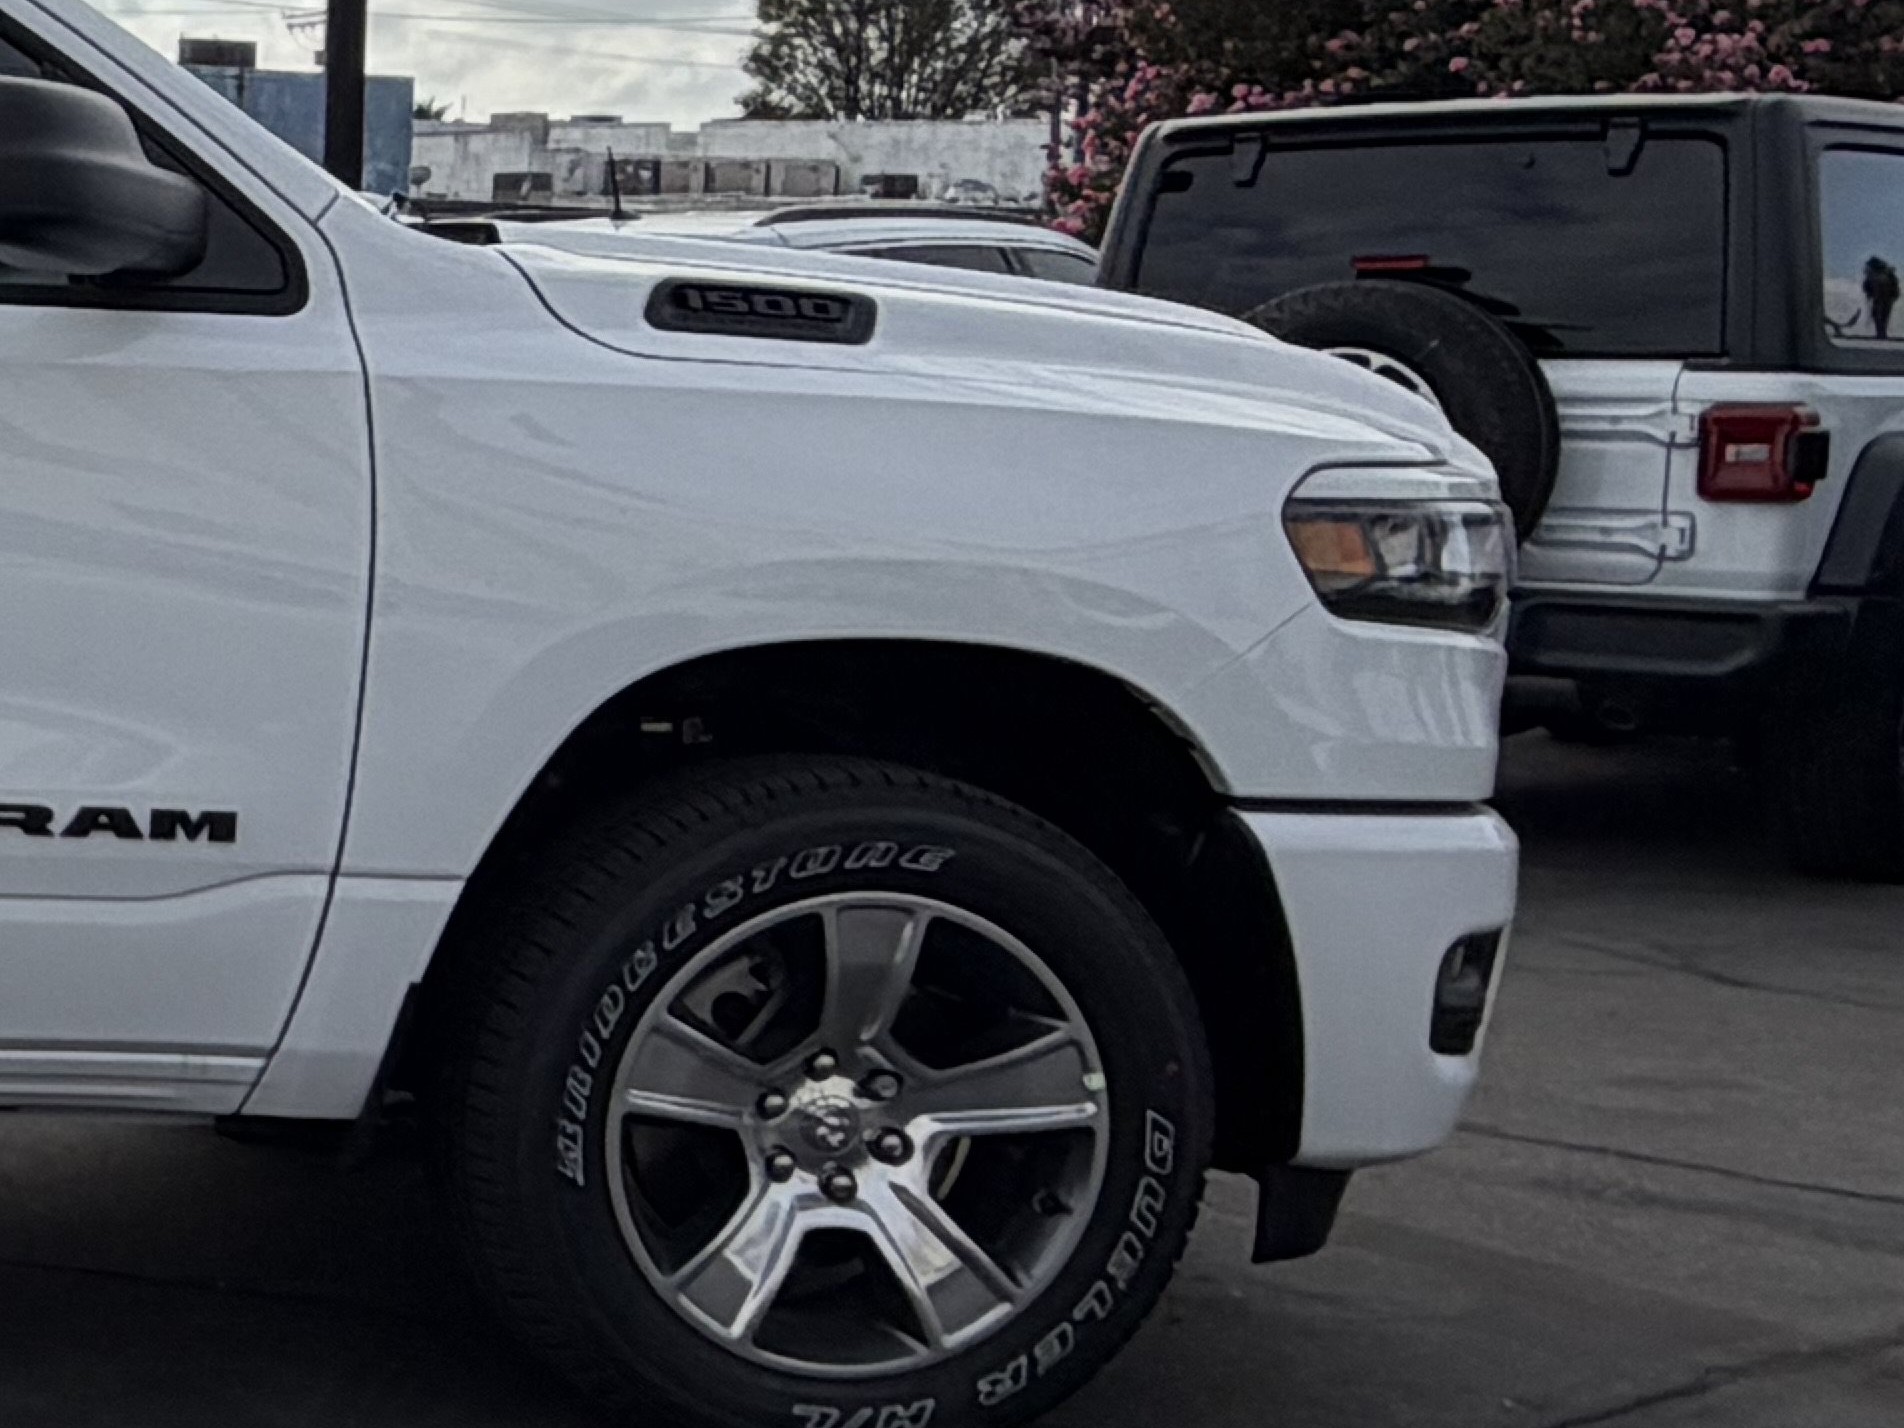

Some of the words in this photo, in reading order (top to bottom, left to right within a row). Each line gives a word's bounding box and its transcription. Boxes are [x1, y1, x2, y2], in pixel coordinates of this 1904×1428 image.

[682, 287, 843, 320] 1500
[556, 841, 956, 1187] BRIDGESTONE
[976, 1108, 1176, 1406] DUELER
